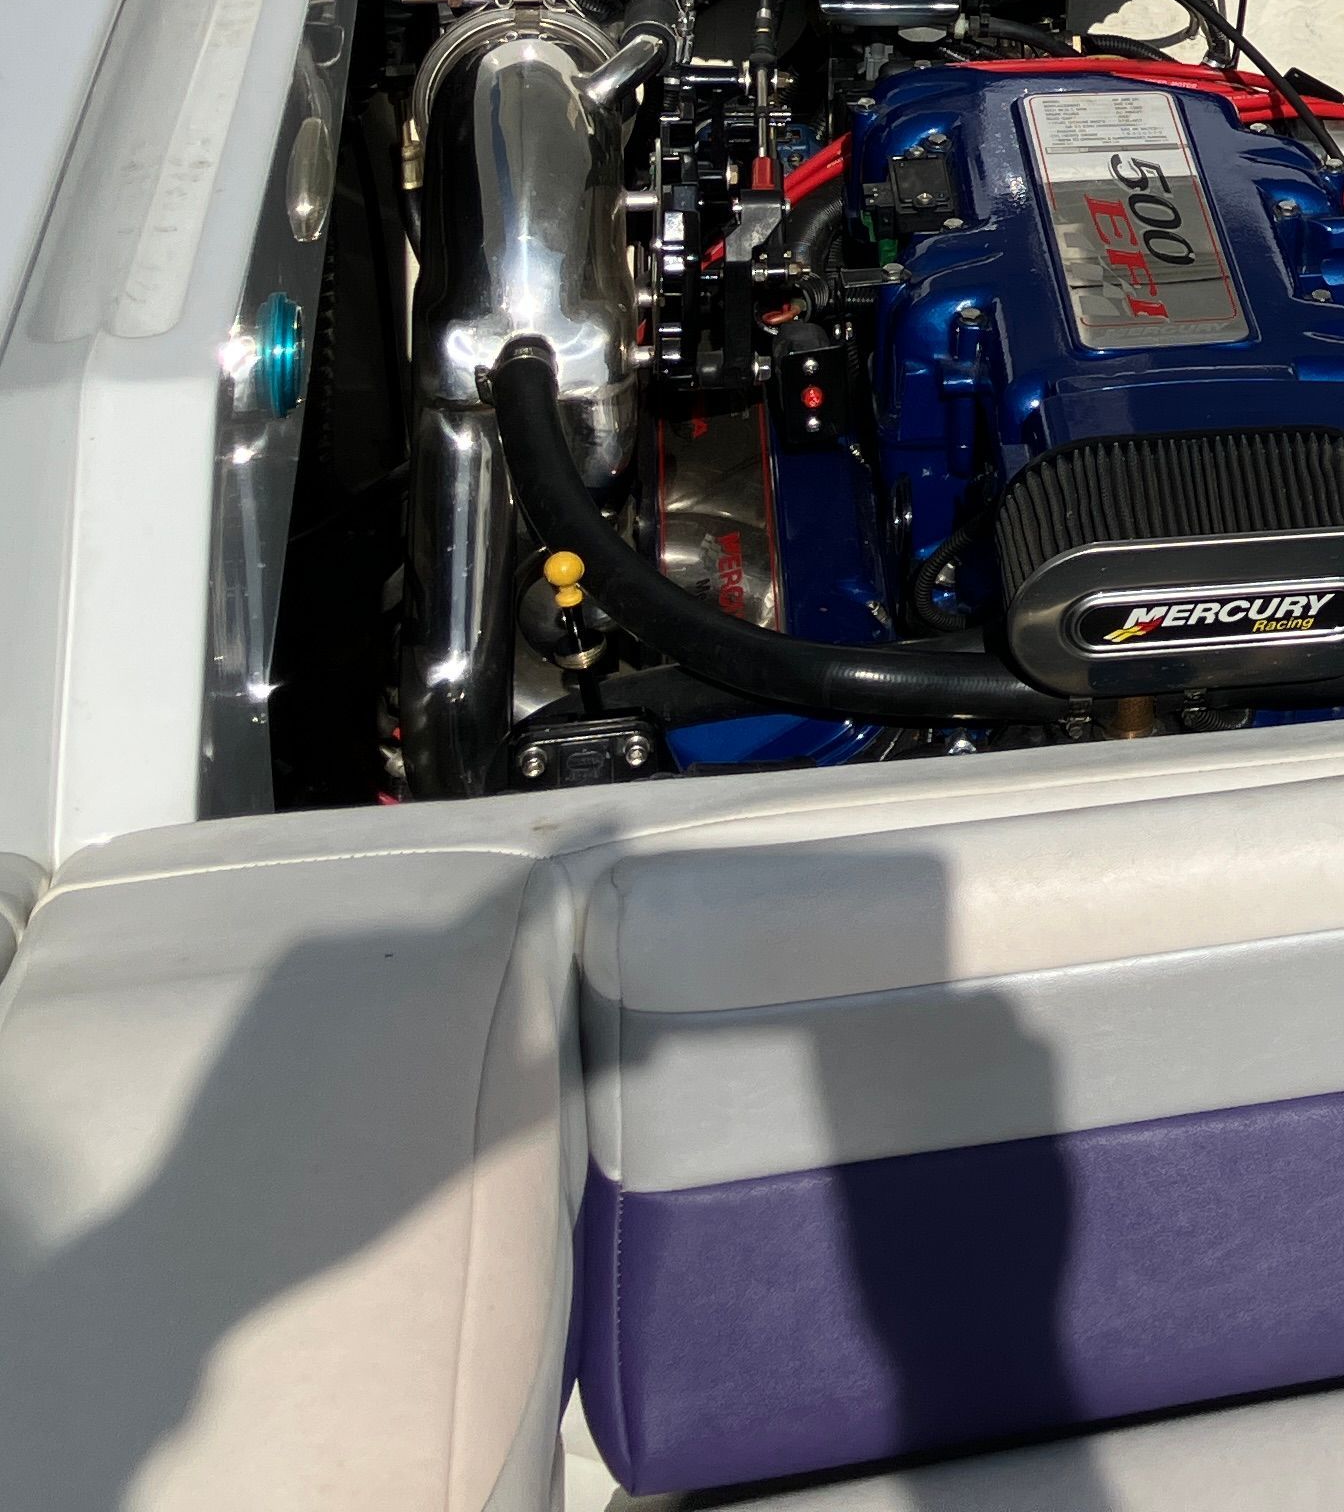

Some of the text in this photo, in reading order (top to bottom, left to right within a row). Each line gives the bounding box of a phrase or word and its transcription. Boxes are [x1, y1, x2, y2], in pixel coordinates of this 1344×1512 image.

[1108, 153, 1196, 266] 500
[1084, 193, 1169, 318] EFI
[1105, 322, 1228, 337] MERCURY
[1122, 593, 1336, 630] MERCURY
[1252, 616, 1315, 633] Racing
